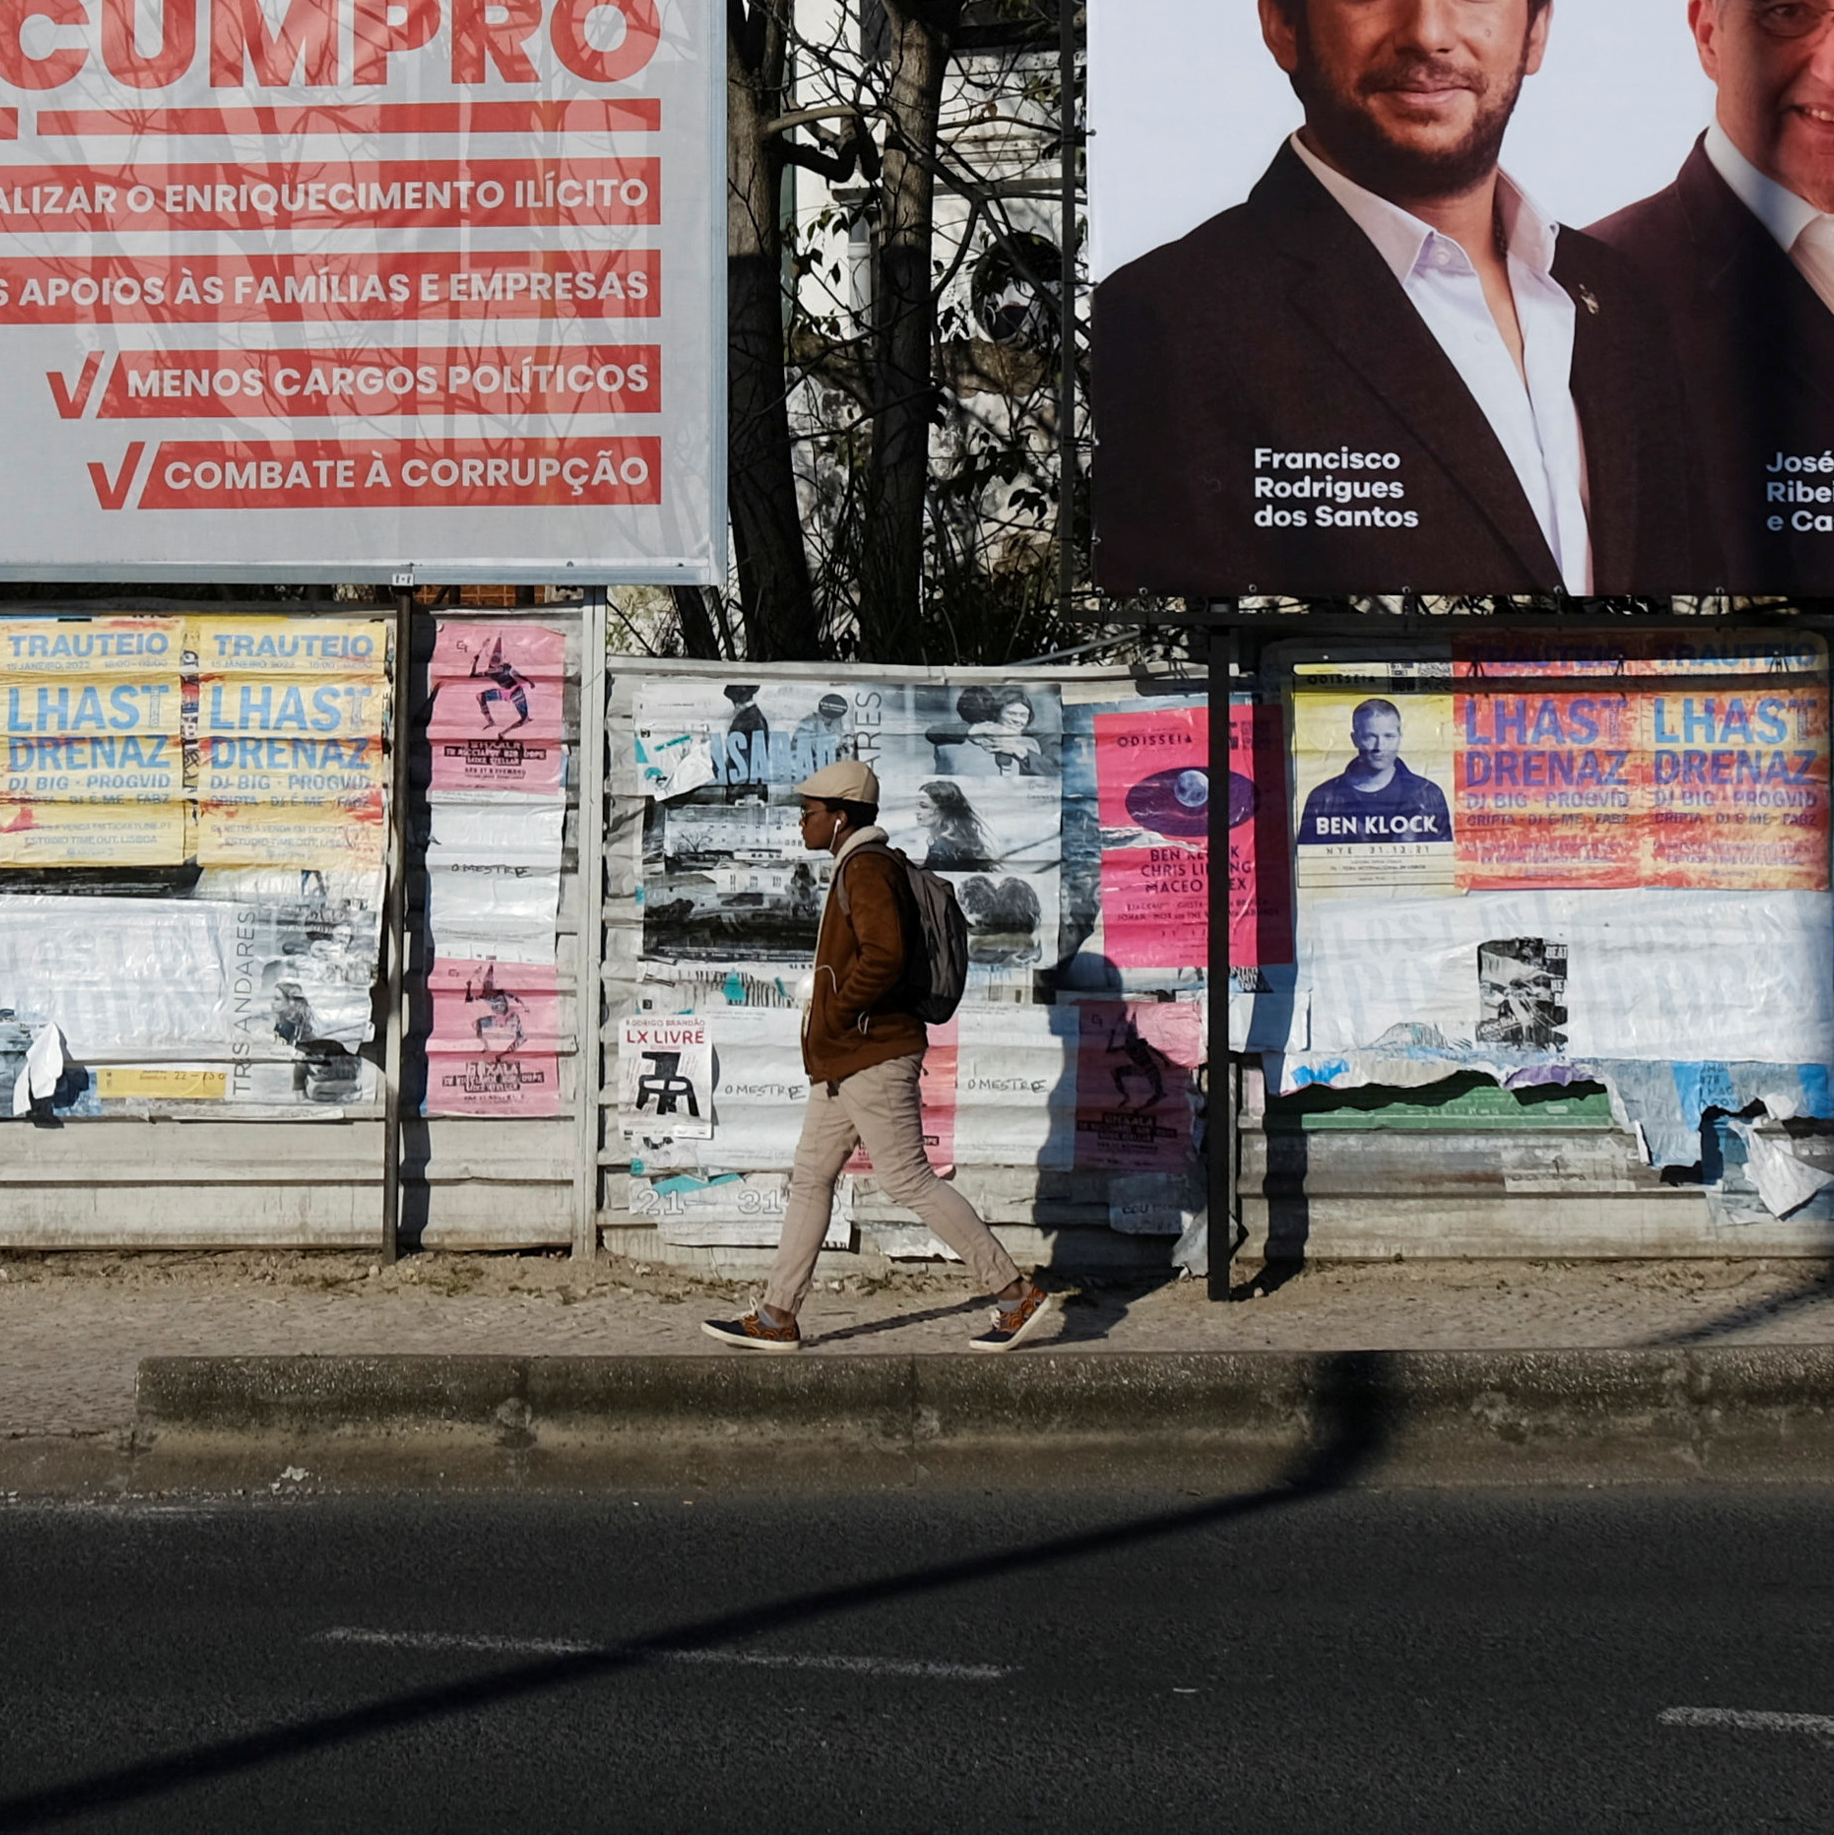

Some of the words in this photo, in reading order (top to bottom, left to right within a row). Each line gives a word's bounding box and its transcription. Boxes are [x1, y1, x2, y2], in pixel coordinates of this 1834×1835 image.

[127, 183, 155, 214] O
[164, 179, 504, 216] ENRIQUECIMENTO
[514, 172, 648, 210] ILÍCITO
[22, 276, 165, 307] APOIOS
[173, 263, 225, 306] ÀS
[235, 263, 410, 304] FAMÍLIAS
[420, 274, 439, 302] E
[450, 271, 648, 302] EMPRESAS
[127, 366, 263, 399] MENOS
[273, 365, 437, 398] CARGOS
[447, 356, 648, 395] POLÍTICOS
[1254, 447, 1401, 470] Francisco
[1767, 449, 1834, 474] José
[164, 458, 356, 491] COMBATE
[365, 447, 392, 489] À
[401, 447, 648, 495] CORRUPÇÃO
[1254, 476, 1404, 504] Rodrigues
[1254, 505, 1307, 528] dos
[1314, 505, 1419, 528] Santos
[1767, 514, 1783, 532] e
[8, 633, 169, 657] TRAUTEIO
[214, 634, 374, 657] TRAUTEIO
[7, 685, 170, 731] LHAST
[210, 685, 372, 731] LHAST
[1465, 699, 1628, 745] LHAST
[1654, 698, 1816, 743] LHAST
[1118, 734, 1192, 747] ODISSEIA
[8, 735, 170, 772] DRENAZ
[211, 736, 371, 770] DRENAZ
[1467, 750, 1629, 786] DRENAZ
[1654, 750, 1816, 785] DRENAZ
[8, 777, 28, 790] DJ
[36, 776, 69, 790] BIG
[87, 775, 170, 788] PROGVID
[210, 775, 229, 790] DJ
[238, 775, 270, 790] BIG
[288, 775, 371, 790] PROGVID
[1494, 792, 1527, 808] BIG
[1545, 792, 1629, 807] PROGVID
[1655, 791, 1673, 806] DJ
[1682, 791, 1714, 806] BIG
[1734, 791, 1816, 807] PROGVID
[1317, 817, 1356, 835] BEN
[1366, 815, 1438, 834] KLOCK
[1151, 849, 1181, 861] BEN
[1141, 861, 1185, 877] CHRIS
[1146, 879, 1203, 893] MACEO
[234, 912, 255, 1031] ANDARES
[626, 1030, 648, 1044] LX
[655, 1030, 705, 1044] LIVRE
